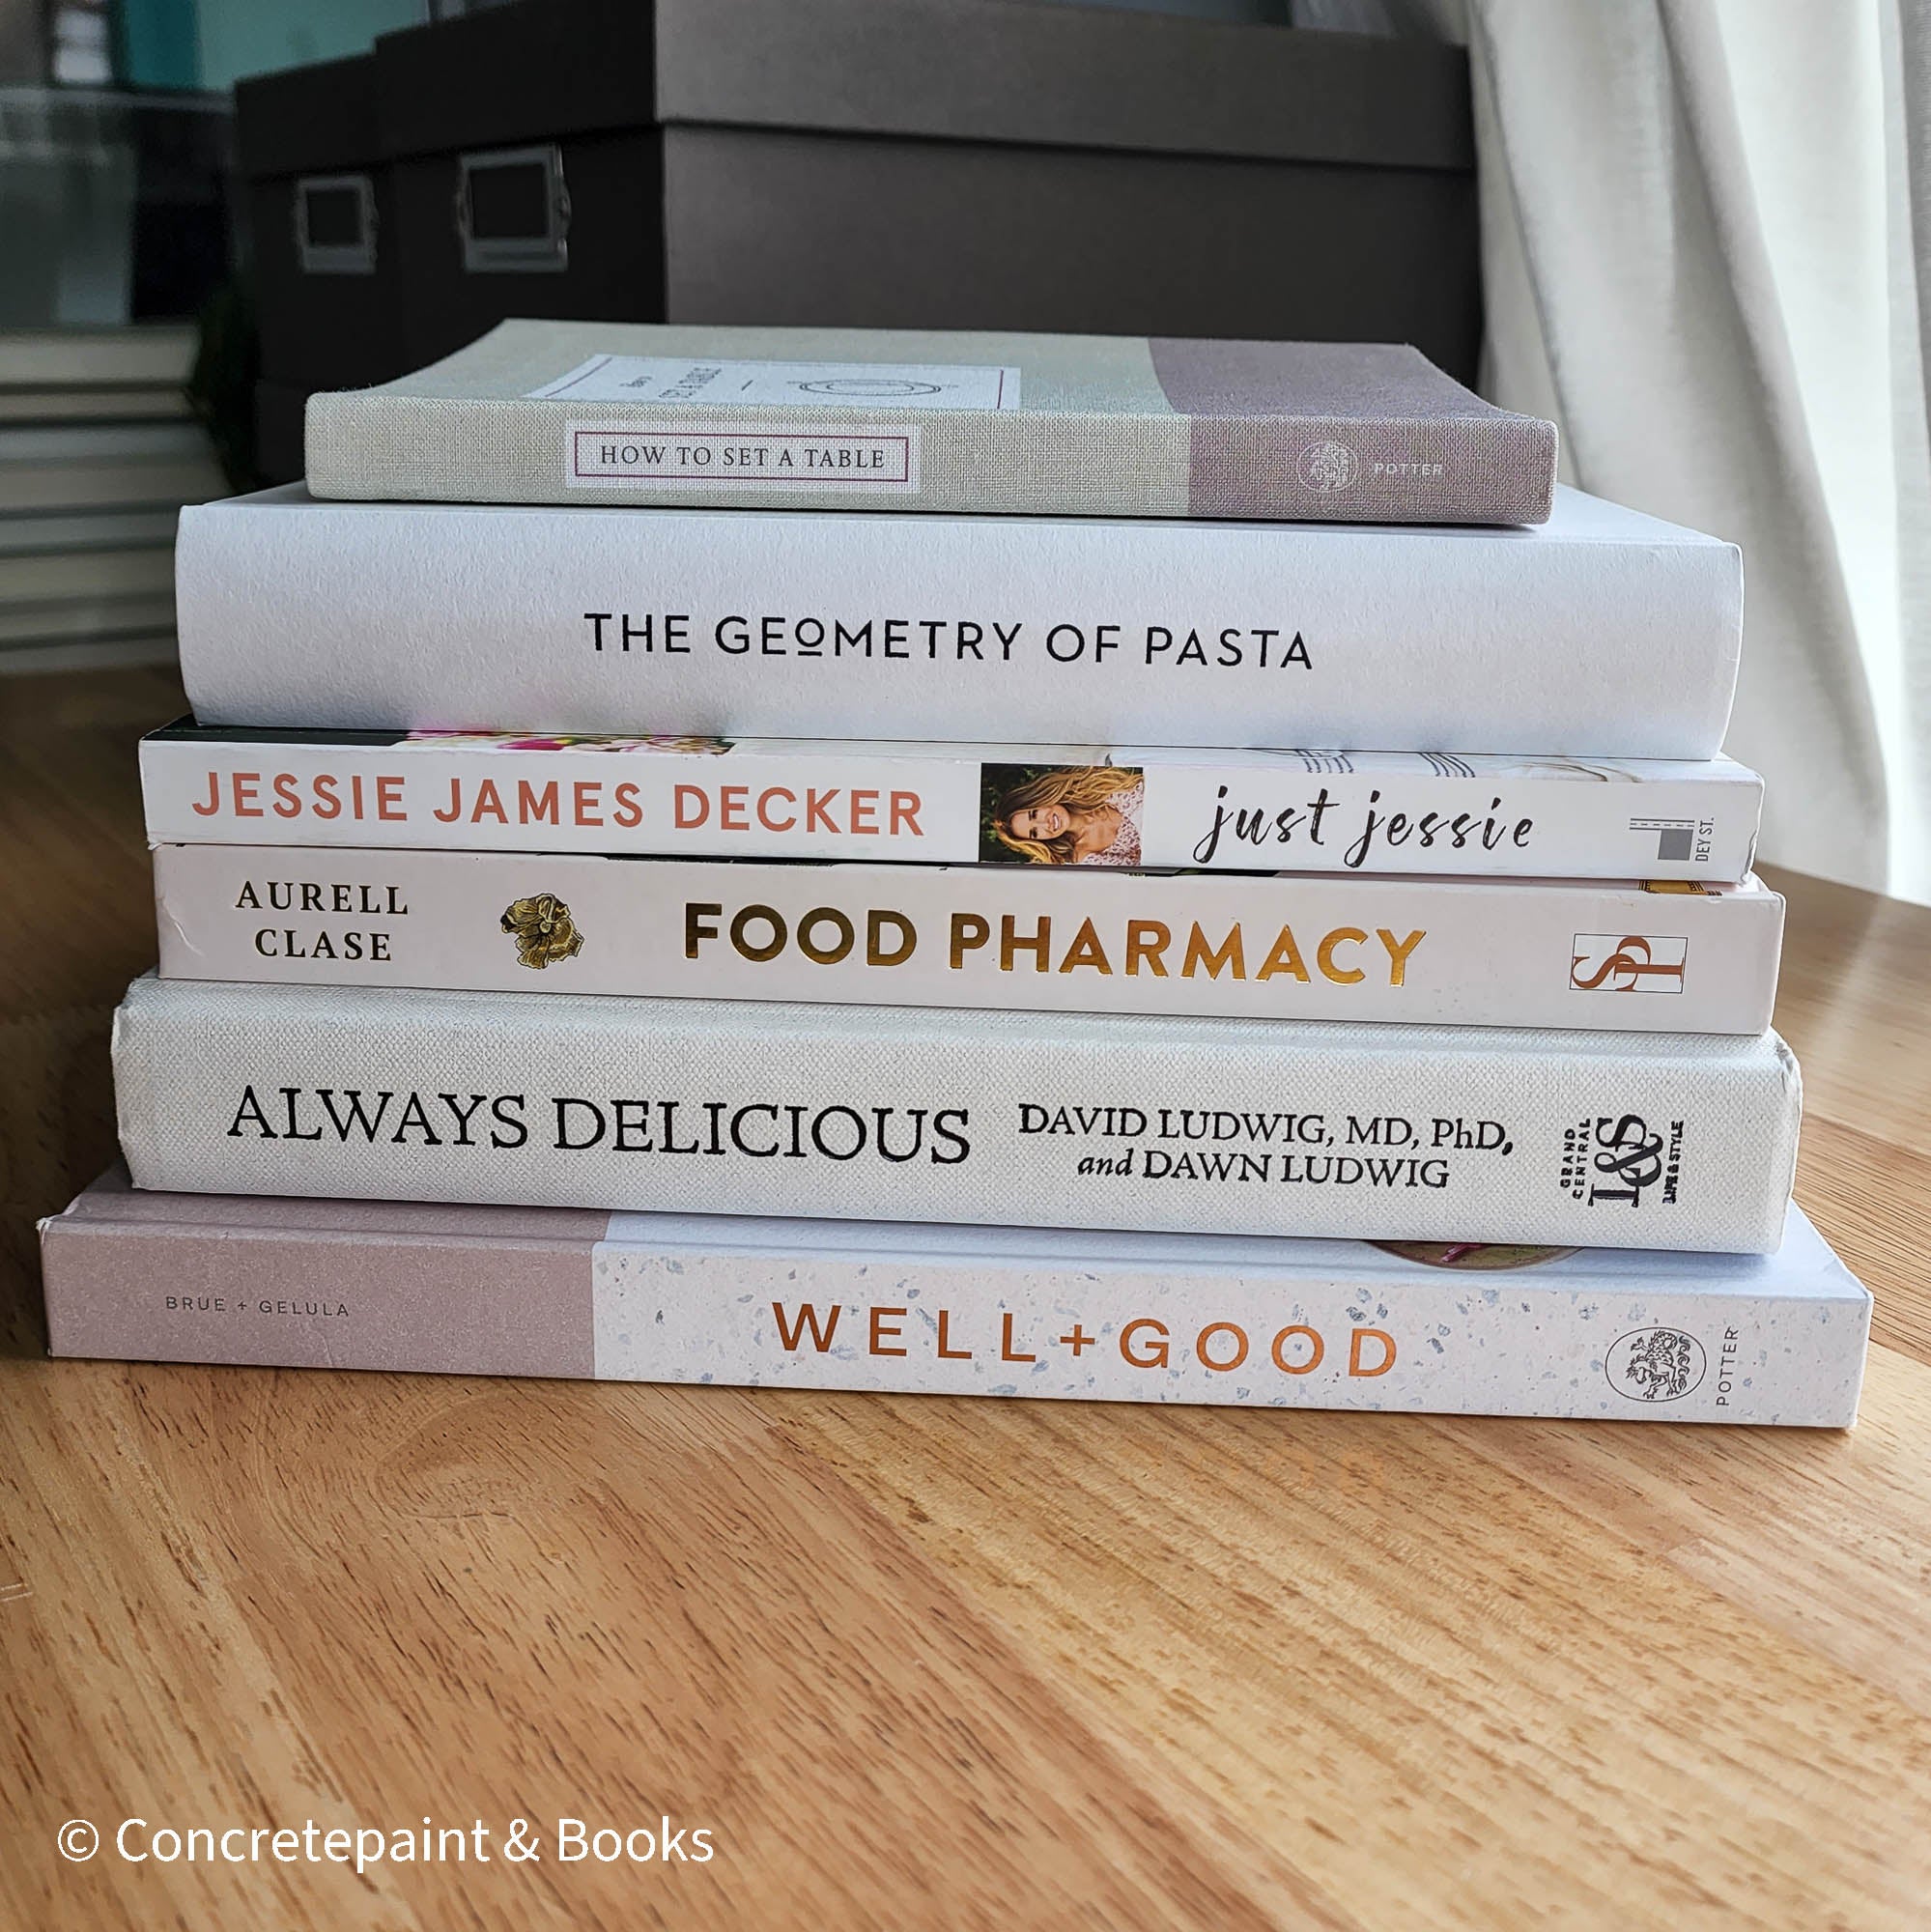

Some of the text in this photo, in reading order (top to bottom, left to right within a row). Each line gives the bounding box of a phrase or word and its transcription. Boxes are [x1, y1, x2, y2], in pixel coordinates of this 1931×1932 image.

[600, 445, 886, 469] HOW TO SET A TABLE
[1374, 462, 1444, 476] POTTER
[583, 613, 1314, 671] THE GEOMETRY OF PASTA
[192, 771, 924, 837] JESSIE JAMES DECKER
[1193, 785, 1535, 868] just jessie
[1694, 817, 1715, 862] DEY ST.
[235, 881, 410, 916] AURELL
[255, 929, 392, 962] CLASE
[685, 903, 1427, 987] FOOD PHARMACY
[227, 1085, 972, 1166] ALWAYS DELICIOUS
[1018, 1103, 1515, 1157] DAVID LUDWIG, MD, PhD,
[1668, 1120, 1685, 1162] STYLE
[1077, 1149, 1451, 1190] and DAWN LUDWIG
[1559, 1128, 1576, 1189] GRAND
[1572, 1118, 1592, 1200] CENTRAL
[165, 1296, 227, 1313] BRUE
[258, 1299, 350, 1318] GELULA
[1716, 1326, 1740, 1406] POTTER
